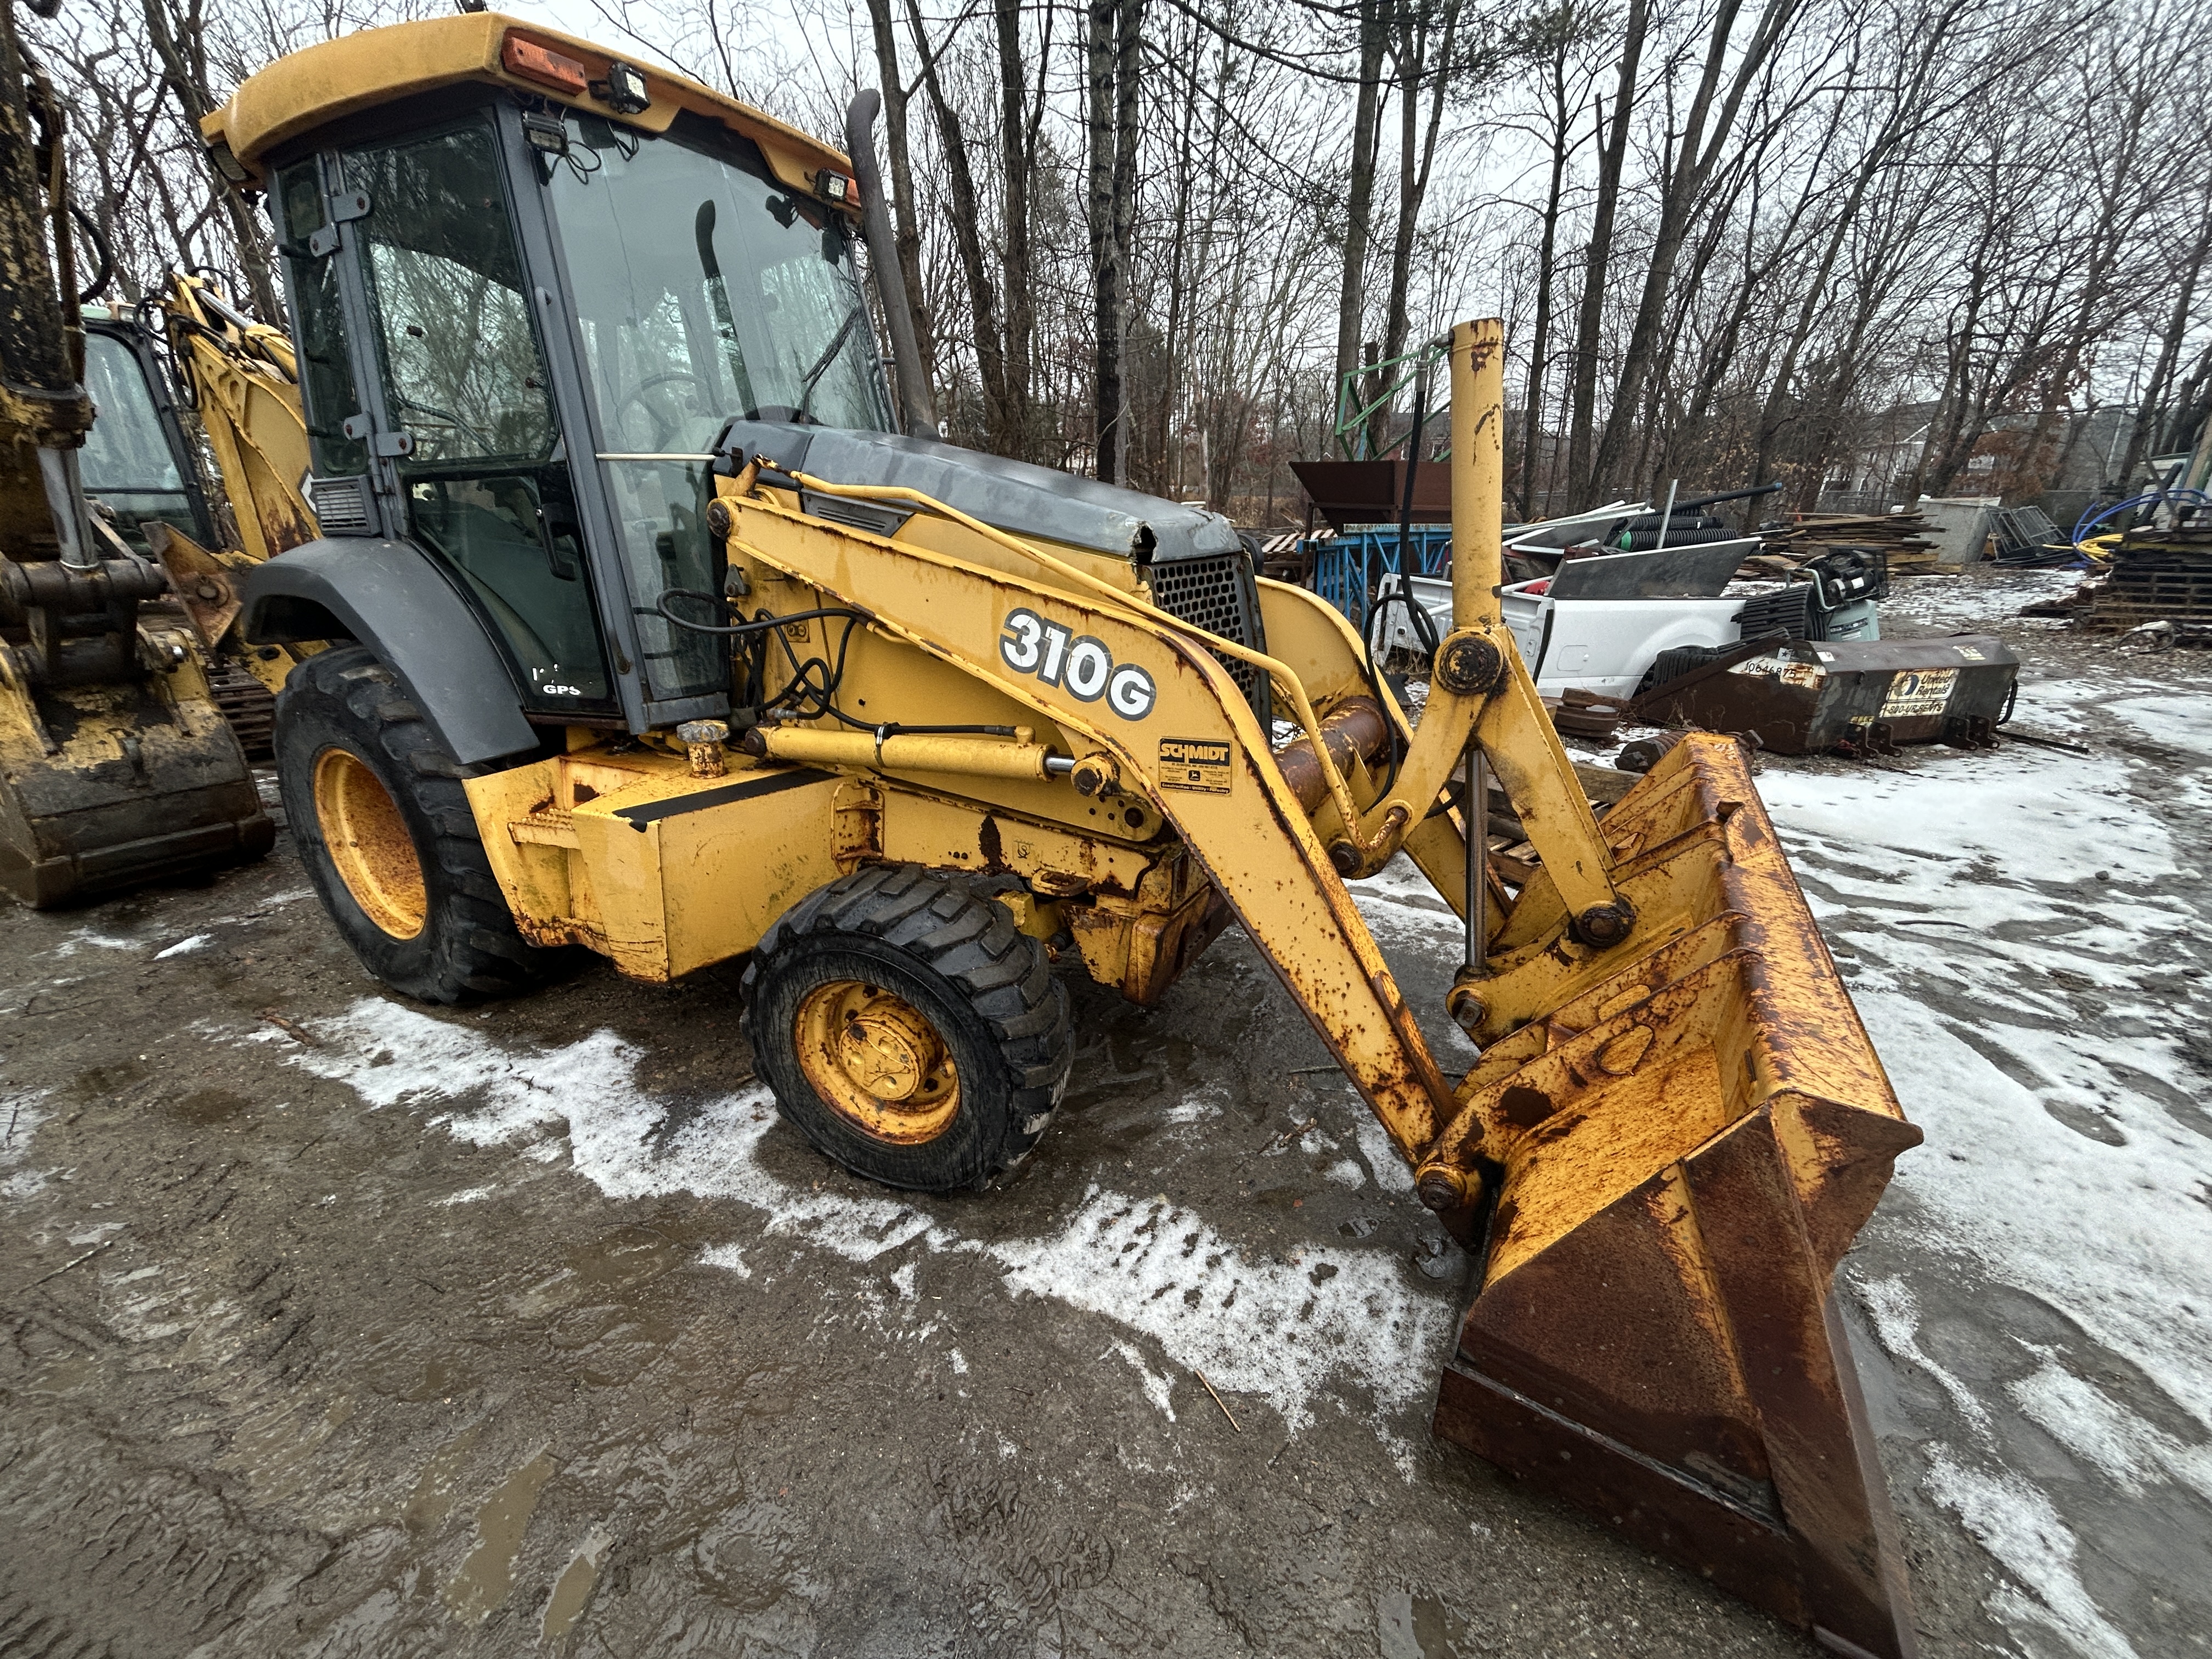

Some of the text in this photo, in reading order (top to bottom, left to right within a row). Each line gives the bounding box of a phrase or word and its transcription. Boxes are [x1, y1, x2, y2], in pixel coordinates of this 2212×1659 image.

[1000, 607, 1156, 721] 310G
[1921, 674, 1953, 685] United
[543, 685, 581, 696] GPS
[1916, 684, 1949, 696] Rentals
[1160, 743, 1228, 764] SCHMIDT
